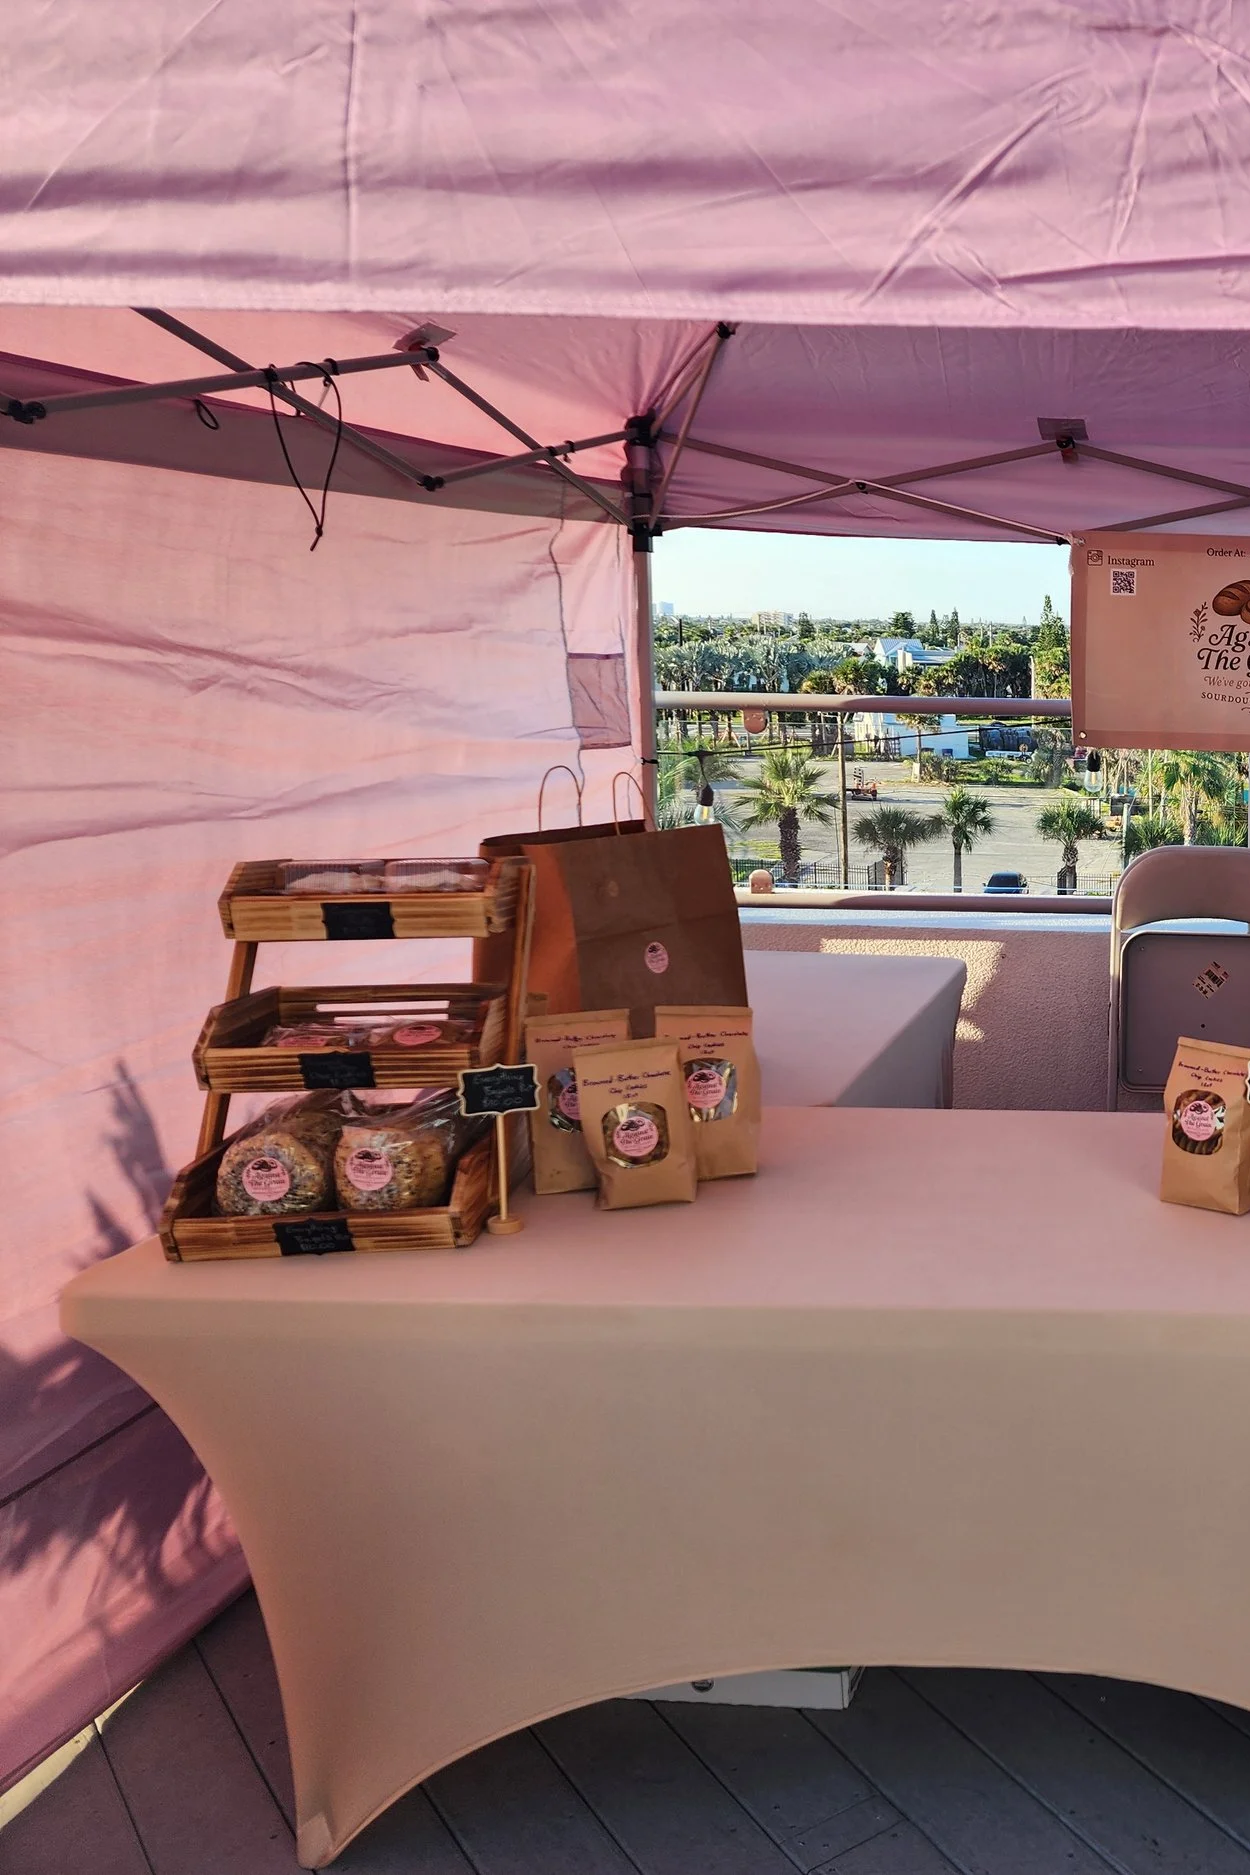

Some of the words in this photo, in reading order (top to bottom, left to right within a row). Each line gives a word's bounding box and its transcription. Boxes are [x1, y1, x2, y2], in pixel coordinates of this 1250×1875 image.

[1207, 547, 1232, 558] Order
[1235, 548, 1247, 558] At:
[1108, 555, 1155, 568] Instagram
[1197, 648, 1241, 671] The
[1203, 676, 1234, 687] We've
